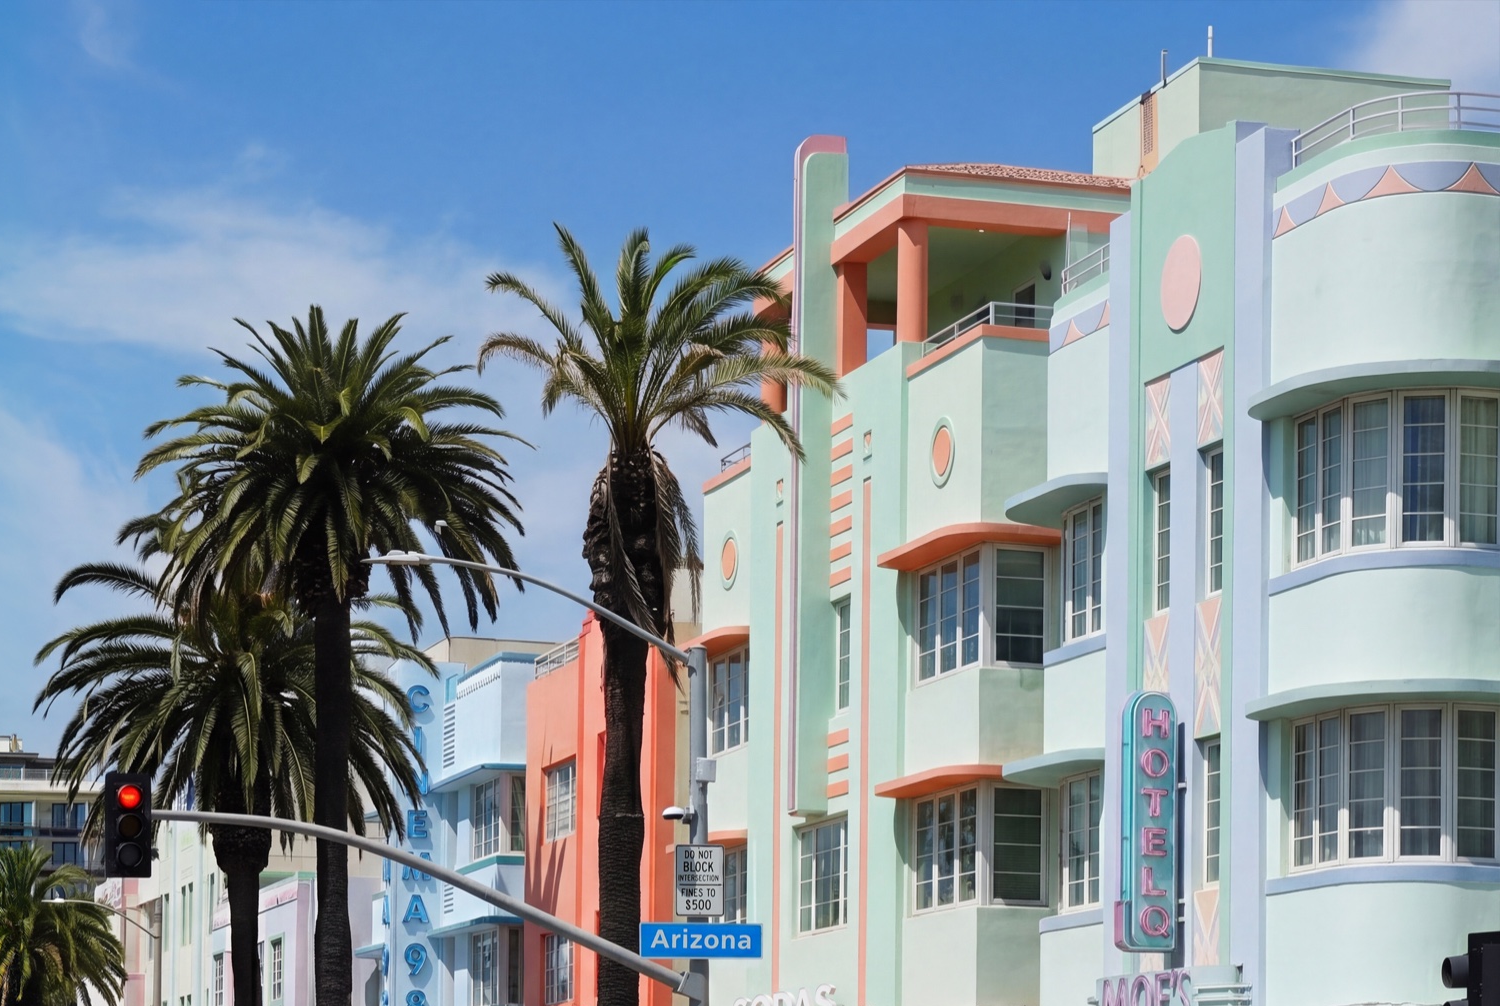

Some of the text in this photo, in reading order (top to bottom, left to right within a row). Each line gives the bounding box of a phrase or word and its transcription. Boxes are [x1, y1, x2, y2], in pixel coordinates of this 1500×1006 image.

[684, 850, 713, 859] DO NOT
[683, 861, 714, 873] BLOCK
[678, 874, 719, 882] INTERSECTION
[681, 888, 716, 898] FINES TO
[685, 899, 712, 910] $500
[650, 928, 751, 949] Arizona
